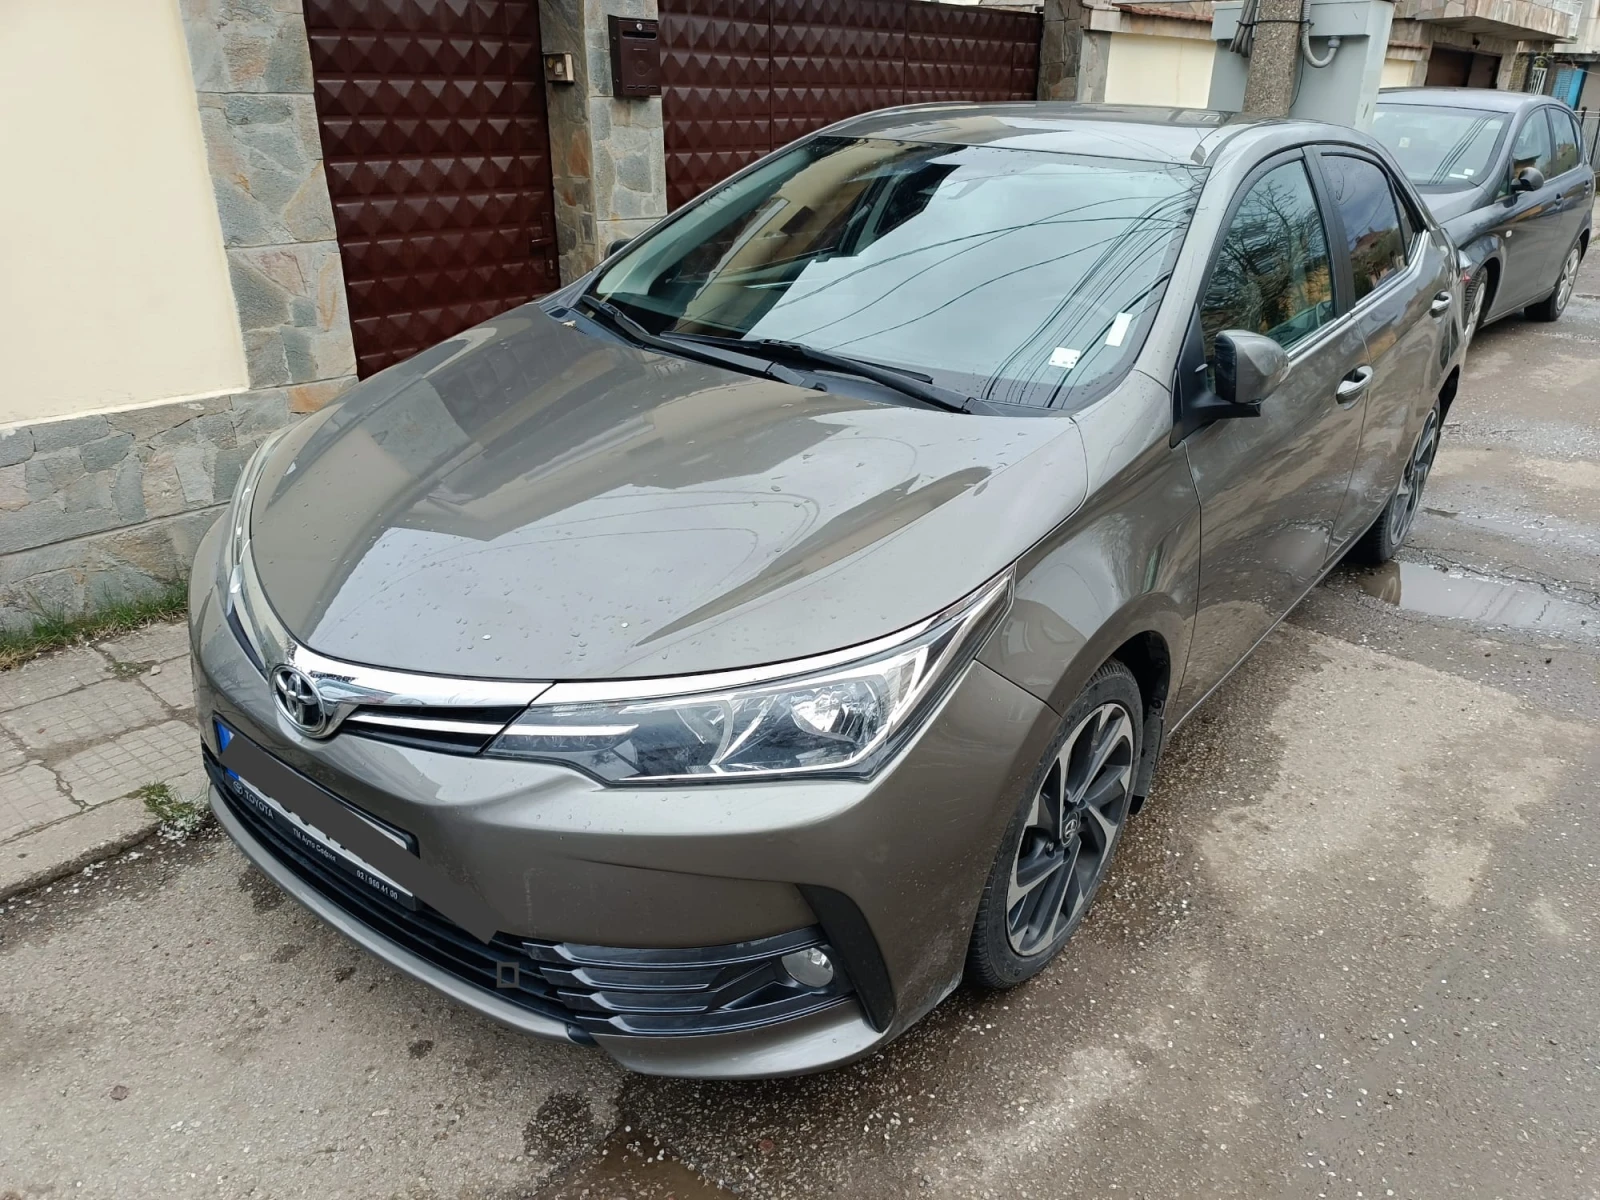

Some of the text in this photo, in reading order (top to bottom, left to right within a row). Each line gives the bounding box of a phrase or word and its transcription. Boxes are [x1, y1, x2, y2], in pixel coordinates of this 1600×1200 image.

[244, 790, 274, 820] TOYOTA
[356, 869, 365, 880] 02
[380, 884, 388, 895] 41
